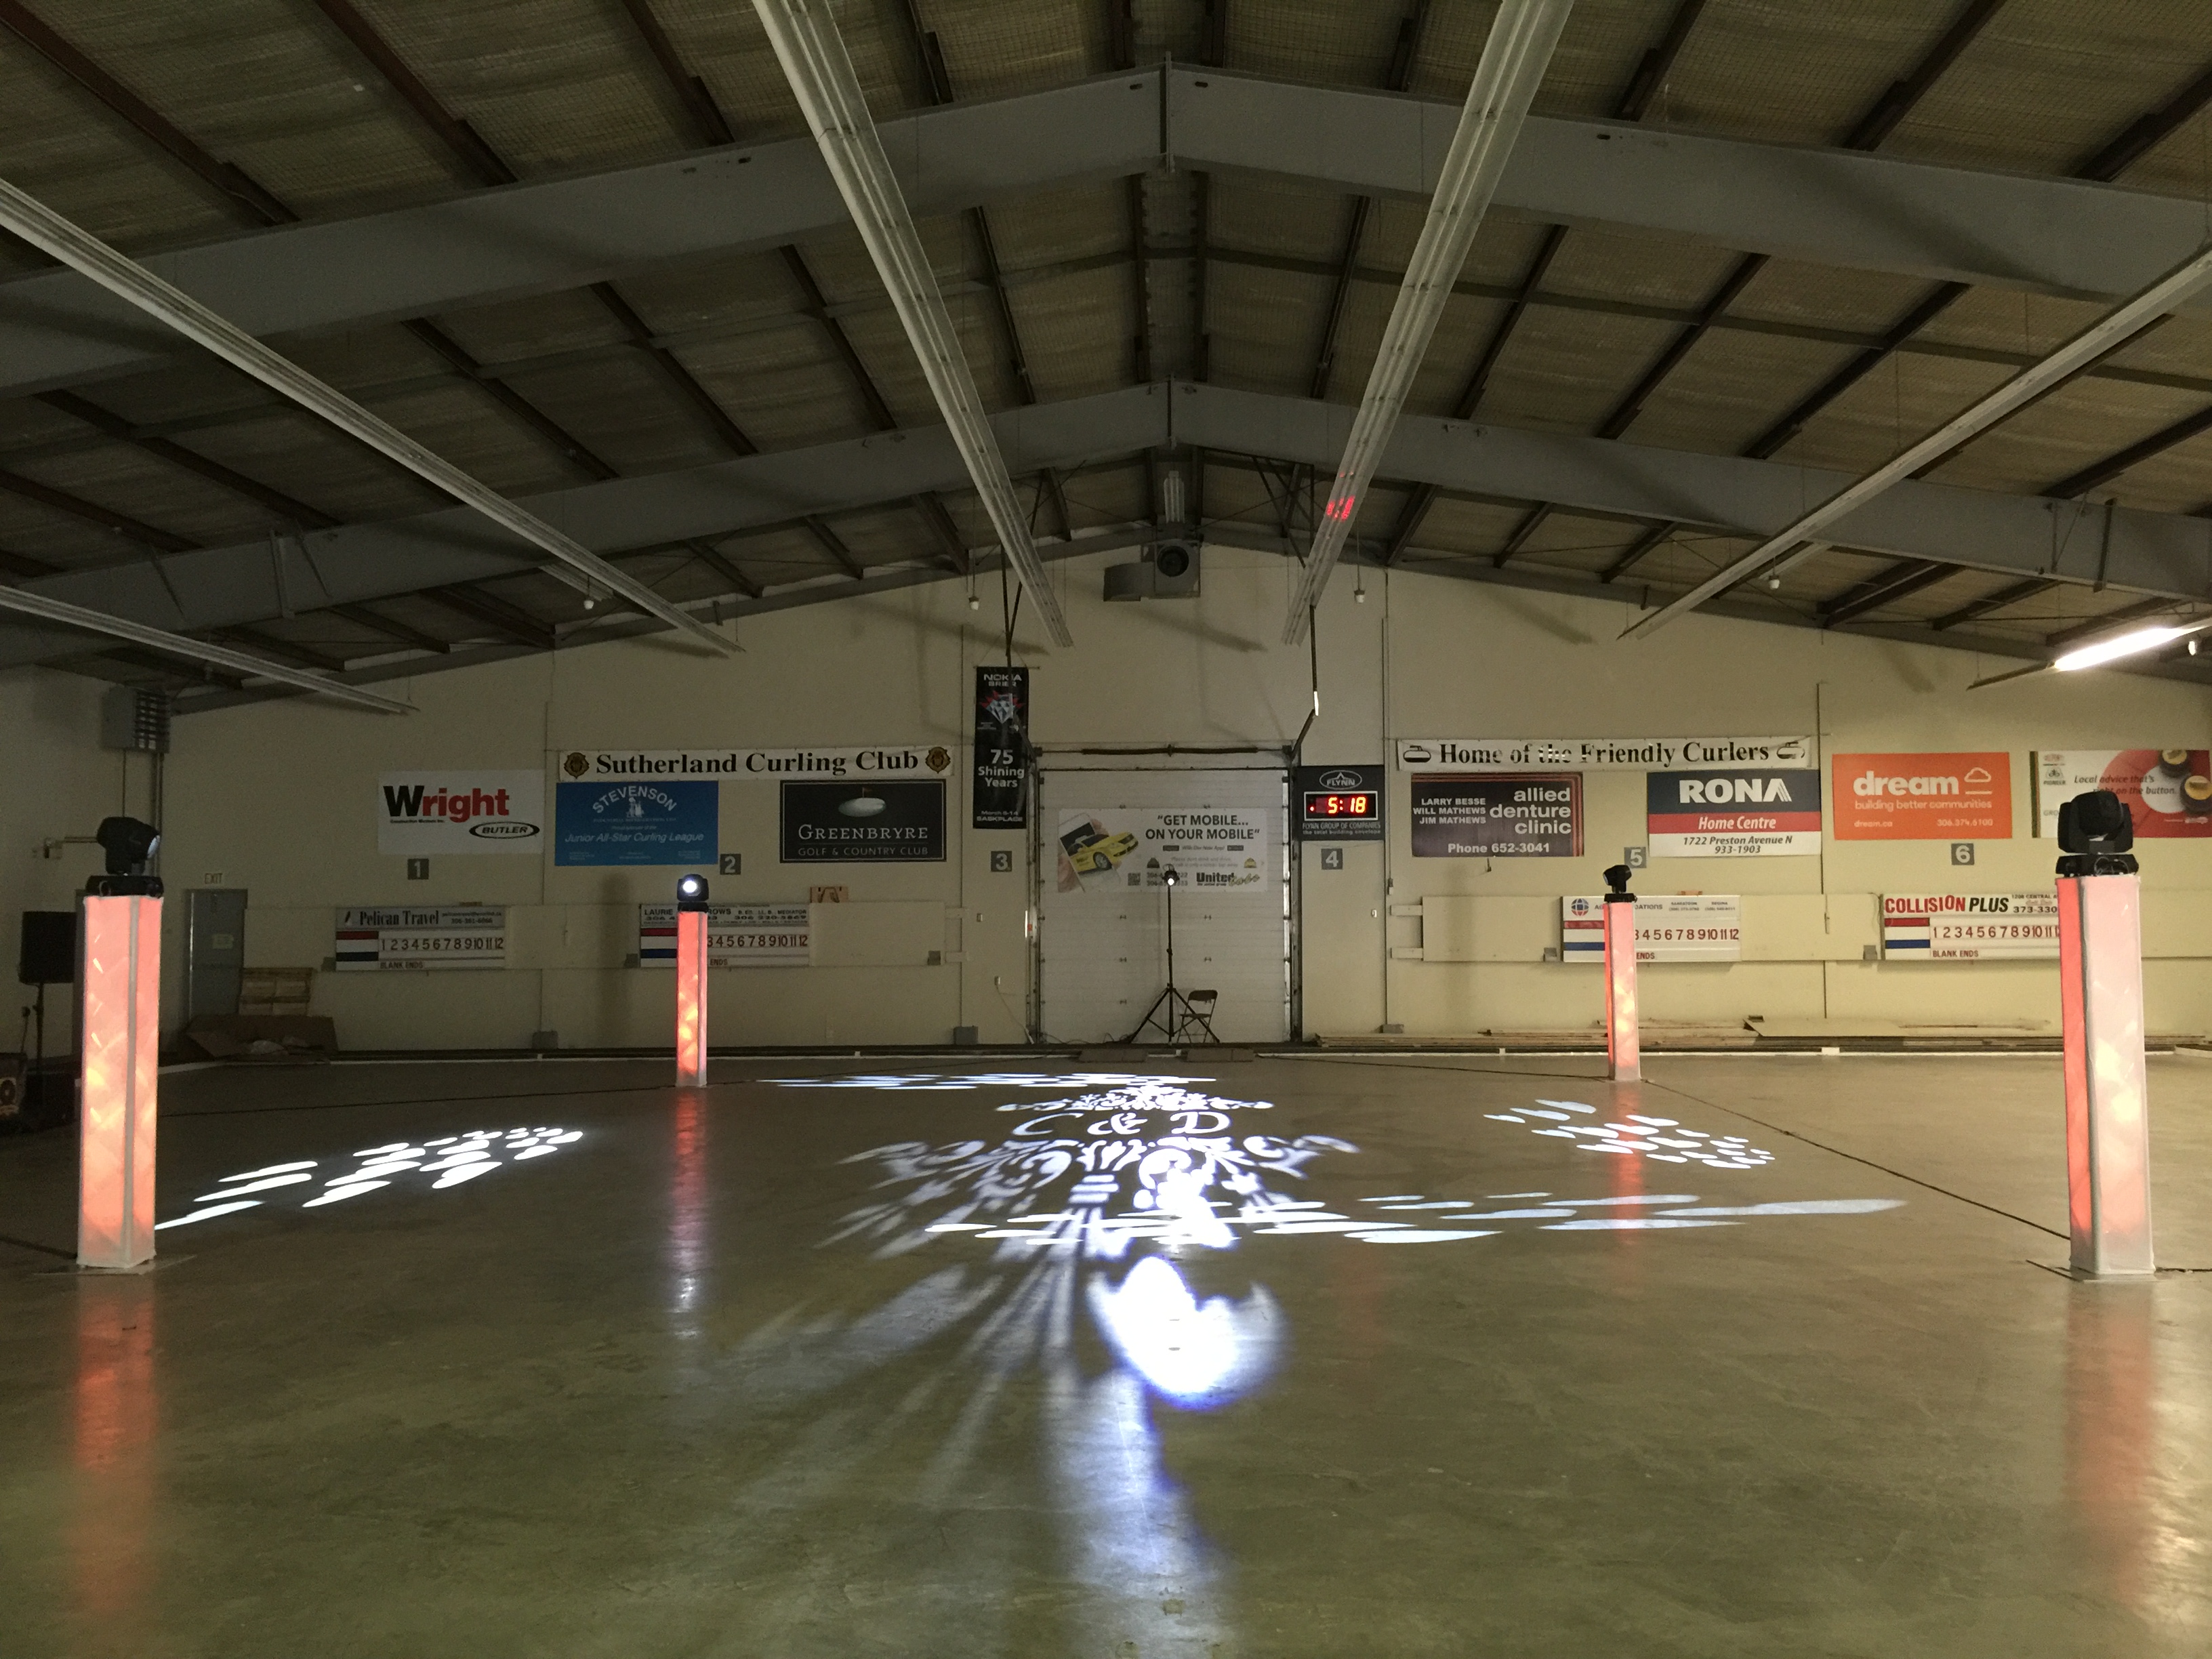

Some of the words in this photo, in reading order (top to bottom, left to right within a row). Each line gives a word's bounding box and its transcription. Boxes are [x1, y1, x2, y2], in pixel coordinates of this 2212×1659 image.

[990, 749, 1013, 765] 75
[1439, 743, 1502, 763] Home
[1511, 743, 1532, 763] of
[1538, 744, 1572, 763] the
[1580, 742, 1675, 768] Friendly
[1683, 741, 1769, 762] Curlers
[596, 754, 737, 774] Sutherland
[745, 752, 846, 776] Curling
[856, 750, 918, 771] Club
[978, 766, 1025, 779] Shining
[2074, 775, 2097, 783] Local
[2100, 775, 2129, 783] advice
[2130, 775, 2154, 783] that's
[985, 777, 1018, 788] Years
[1327, 778, 1355, 787] FLYNN
[1853, 771, 1959, 796] dream
[1513, 787, 1570, 802] allied
[1679, 778, 1792, 804] RONA
[383, 785, 510, 823] Wright
[592, 785, 677, 813] STEVENSON
[1328, 796, 1366, 815] 5:18
[1855, 798, 1894, 813] building
[1896, 798, 1927, 809] better
[1929, 798, 1992, 809] communities
[1490, 804, 1571, 818] denture
[1190, 815, 1248, 826] MOBILE...
[1439, 816, 1486, 824] MATHEWS
[1515, 820, 1572, 834] clinic
[1698, 816, 1734, 830] Home
[1737, 816, 1776, 829] Centre
[1854, 819, 1893, 827] dream.ca
[482, 826, 529, 834] BUTLER
[798, 823, 928, 840] GREENBRYRE
[1145, 828, 1164, 840] ON
[1169, 828, 1203, 840] YOUR
[1206, 828, 1260, 840] MOBILE"
[565, 834, 594, 842] Junior
[597, 832, 632, 842] All-Star
[634, 832, 667, 844] Curling
[670, 833, 703, 843] League
[1683, 836, 1706, 845] 1722
[1709, 836, 1746, 845] Preston
[1748, 836, 1784, 845] Avenue
[1785, 836, 1793, 844] N
[798, 846, 827, 856] GOLF
[832, 846, 839, 855] &
[844, 846, 895, 856] COUNTRY
[900, 846, 928, 855] CLUB
[1448, 843, 1487, 853] Phone
[1491, 843, 1550, 853] 652-3041
[1715, 845, 1761, 854] 933-1903
[1955, 845, 1971, 863] 6
[996, 853, 1008, 871] 3
[1326, 851, 1339, 867] 4
[1630, 849, 1642, 866] 5
[414, 861, 421, 878] 1
[724, 856, 736, 874] 2
[205, 873, 222, 884] EXIT
[1197, 872, 1235, 882] United
[1885, 895, 1965, 913] COLLISION
[1969, 897, 2009, 913] PLUS
[360, 911, 400, 926] Pelican
[403, 909, 440, 926] Travel
[1643, 929, 1650, 940] 4
[1654, 929, 1661, 940] 5
[1665, 929, 1673, 940] 6
[1676, 929, 1683, 940] 7
[1687, 929, 1694, 940] 8
[1698, 929, 1705, 940] 9
[1708, 929, 1718, 940] 10
[1720, 929, 1727, 940] 11
[1729, 929, 1739, 940] 12
[1943, 927, 1950, 938] 2
[1954, 927, 1962, 938] 3
[1965, 927, 1973, 938] 4
[1978, 927, 1985, 938] 5
[1988, 927, 1996, 938] 6
[2001, 927, 2007, 938] 7
[2011, 927, 2019, 938] 8
[2022, 927, 2030, 938] 9
[2032, 927, 2043, 938] 10
[2045, 927, 2052, 938] 11
[382, 939, 386, 950] 1
[391, 939, 398, 950] 2
[401, 939, 409, 950] 3
[411, 939, 419, 950] 4
[422, 939, 430, 950] 5
[433, 939, 441, 950] 6
[444, 939, 451, 950] 7
[454, 939, 462, 950] 8
[464, 939, 472, 950] 9
[474, 939, 484, 950] 10
[486, 939, 492, 950] 11
[495, 939, 504, 950] 12
[716, 935, 723, 947] 4
[726, 935, 734, 947] 5
[737, 935, 745, 947] 6
[748, 935, 756, 947] 7
[758, 935, 766, 947] 8
[769, 935, 777, 947] 9
[778, 935, 787, 947] 10
[790, 935, 796, 947] 11
[799, 935, 808, 947] 12
